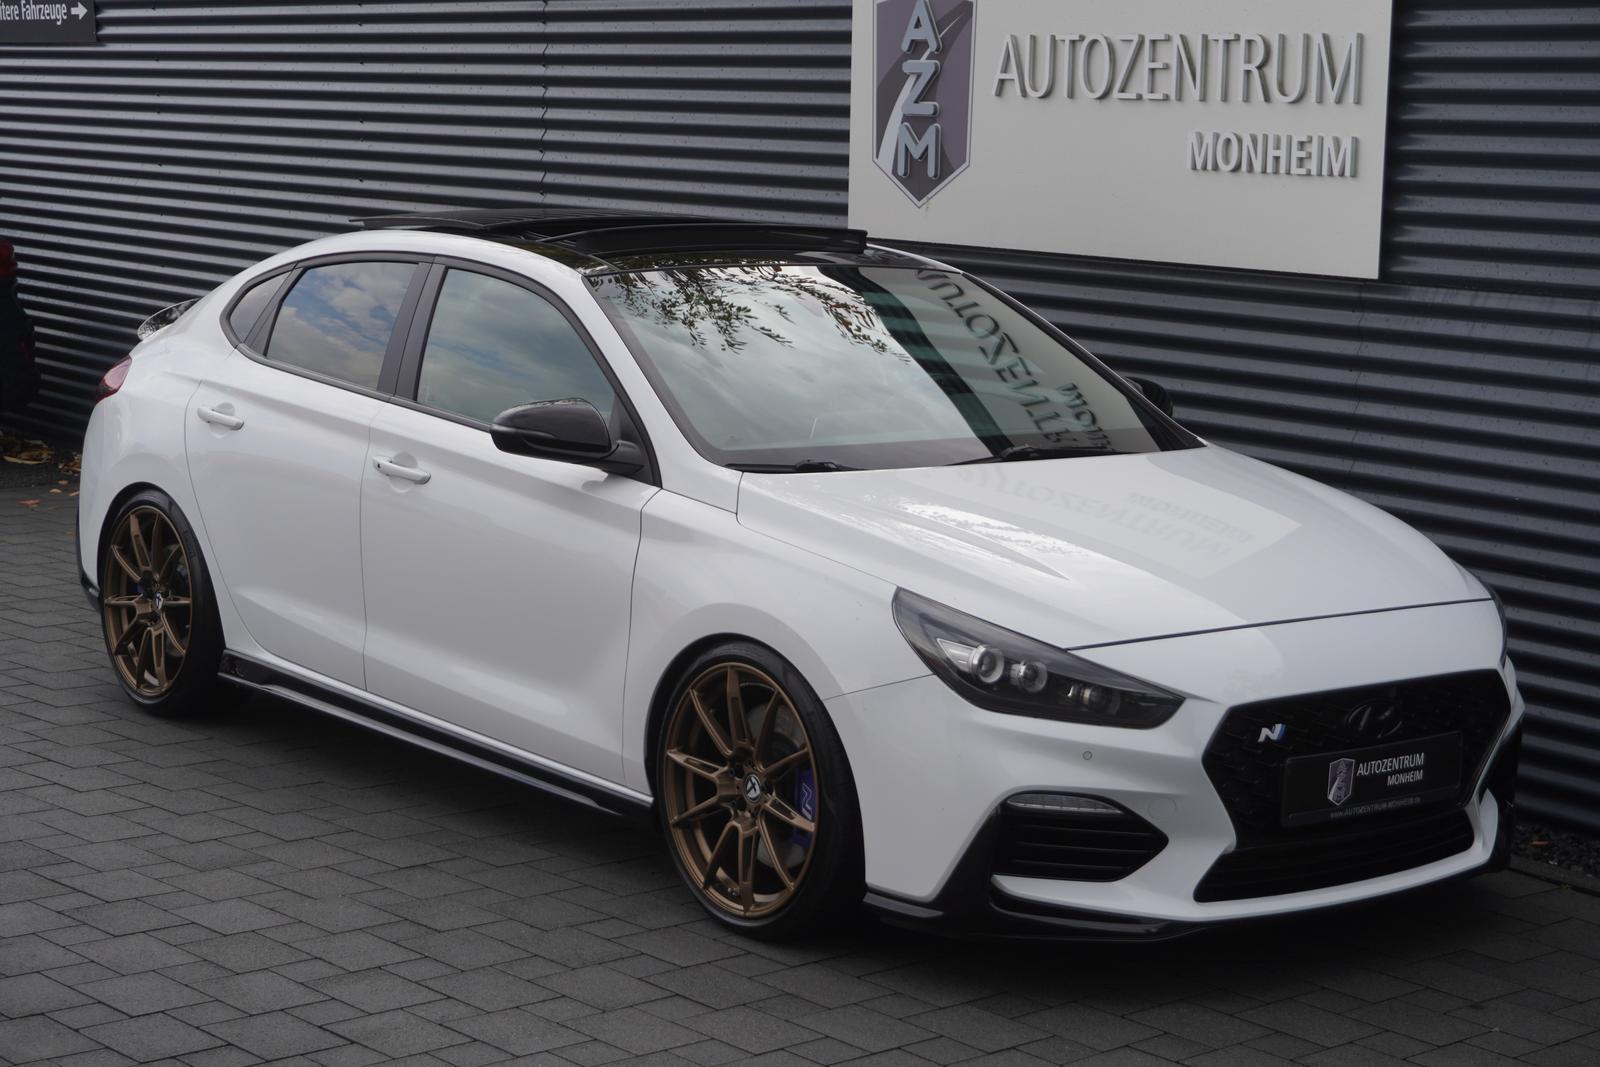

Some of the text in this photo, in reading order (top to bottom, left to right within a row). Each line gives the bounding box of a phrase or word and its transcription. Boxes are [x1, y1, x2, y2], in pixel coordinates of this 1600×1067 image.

[21, 0, 67, 25] Fahrzeuge
[992, 32, 1364, 105] AUTOZENTRUM
[1186, 131, 1359, 178] MONHEIM
[1257, 723, 1286, 743] N
[1356, 752, 1425, 776] AUTOZENTRUM
[1387, 769, 1423, 786] MONHEIM
